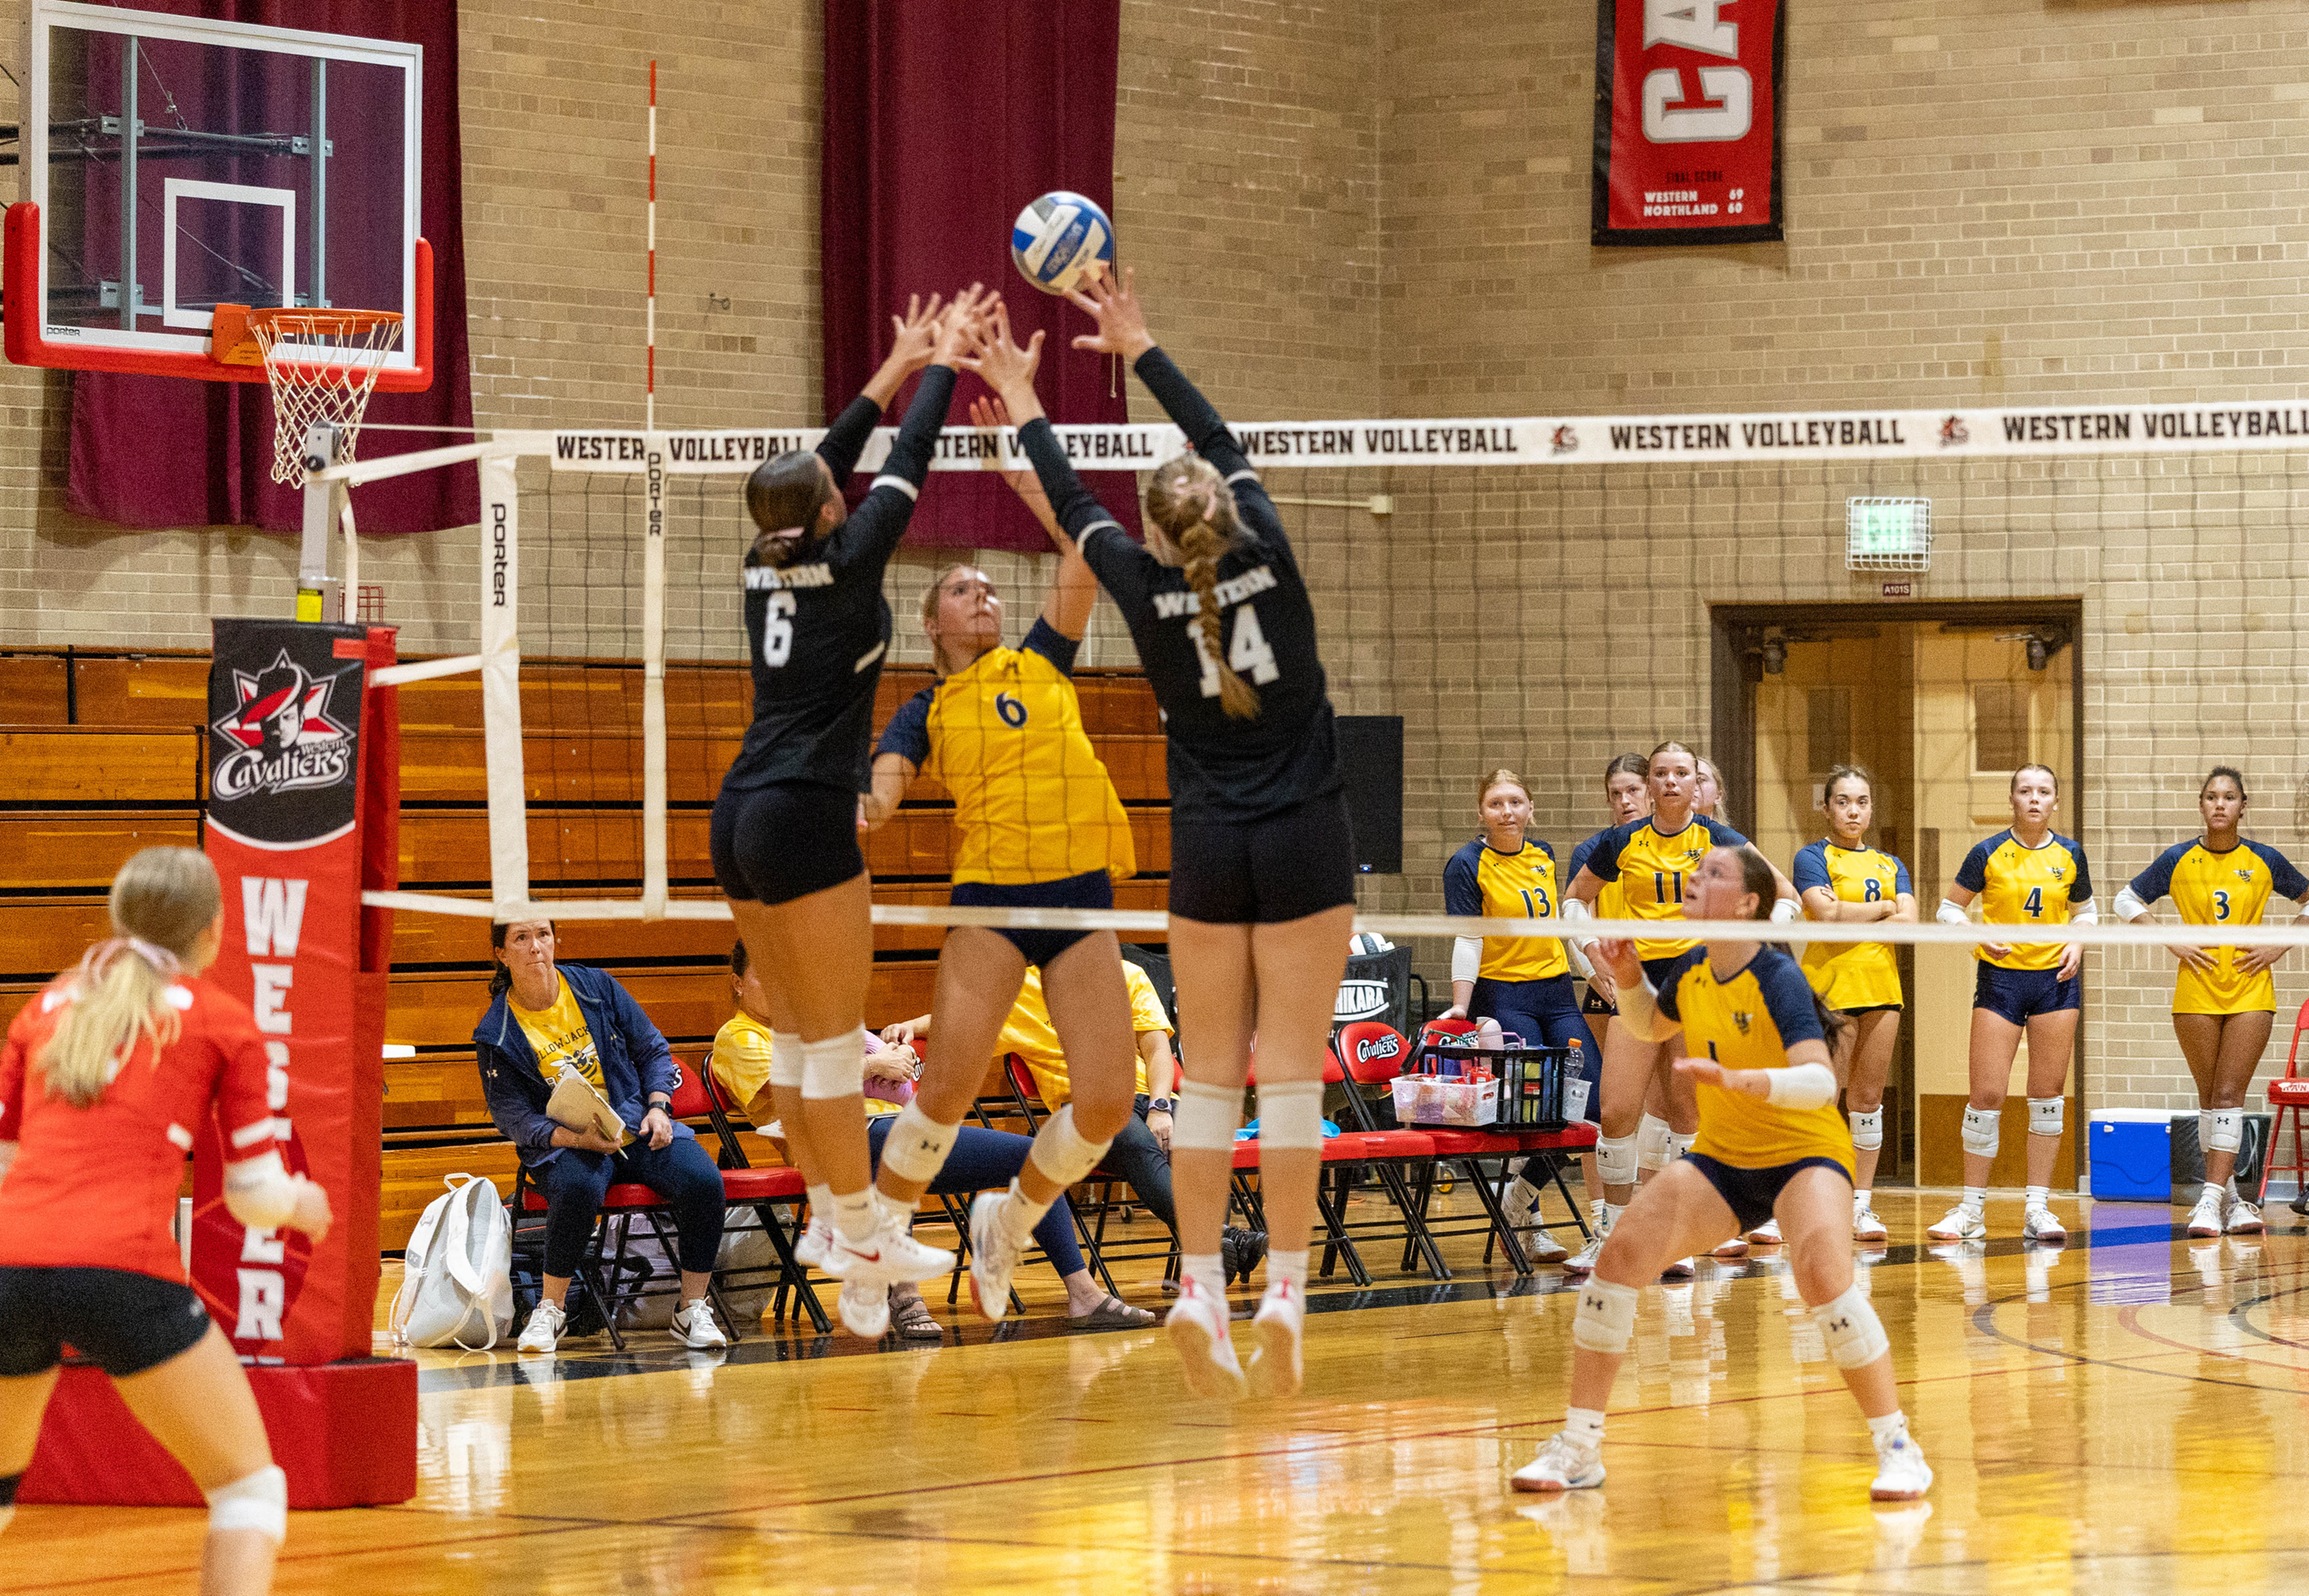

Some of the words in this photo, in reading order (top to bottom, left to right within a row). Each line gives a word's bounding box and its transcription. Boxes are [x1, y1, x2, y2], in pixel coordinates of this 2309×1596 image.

[1643, 204, 1719, 217] NORTHLAND
[1727, 202, 1743, 214] 60
[1644, 190, 1698, 203] WESTERN
[1729, 188, 1744, 200] 69
[1239, 430, 1354, 455] WESTERN
[1365, 427, 1518, 453] VOLLEYBALL
[1610, 424, 1730, 450] WESTERN
[1743, 420, 1905, 448] VOLLEYBALL
[2003, 413, 2131, 441] WESTERN
[557, 436, 645, 460] WESTER
[743, 562, 835, 590] WESTERN
[1153, 564, 1278, 619] WETERN
[763, 591, 798, 668] 6
[1186, 602, 1281, 699] 14
[995, 691, 1028, 729] 6
[1519, 886, 1551, 920] 13
[1652, 870, 1684, 905] 11
[1863, 876, 1883, 902] 8
[2022, 886, 2045, 919] 4
[2213, 890, 2232, 922] 3
